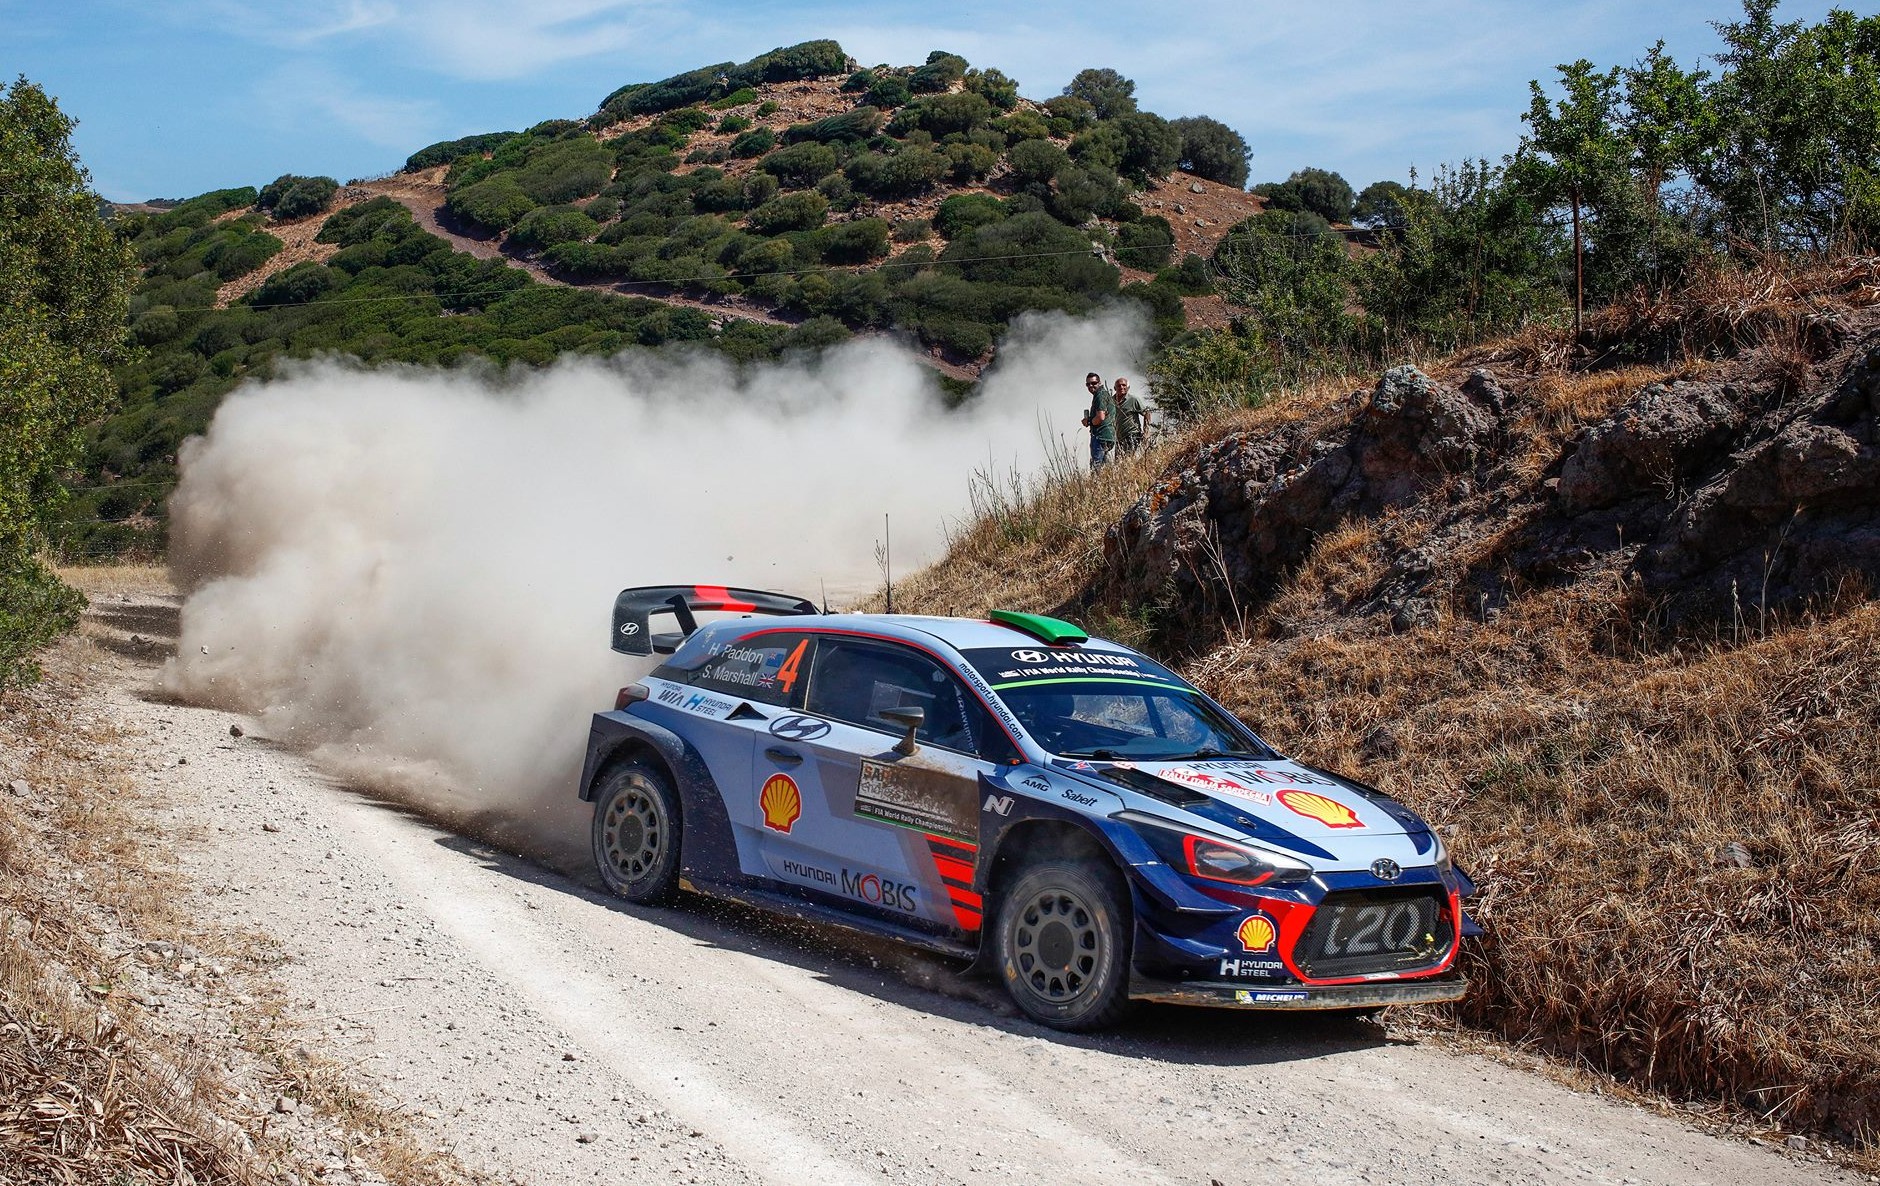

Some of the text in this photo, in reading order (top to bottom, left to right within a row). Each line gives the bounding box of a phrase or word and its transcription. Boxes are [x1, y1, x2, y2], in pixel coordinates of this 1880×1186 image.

[708, 643, 764, 664] H. Paddon
[1051, 651, 1139, 668] HYUNDAI
[776, 638, 809, 693] 4
[1025, 667, 1042, 676] FIA
[1043, 666, 1067, 675] World
[1067, 665, 1089, 675] Rally
[1087, 667, 1140, 678] Championship
[702, 664, 758, 686] S. Marshall
[695, 705, 717, 716] STEEL
[702, 696, 734, 712] HYUNDAI
[959, 662, 1024, 741] motorsport.hyundai.com
[1186, 761, 1268, 771] HYUNDAI
[1021, 779, 1050, 792] AMG
[1162, 770, 1270, 802] RALLY ITALIA SARDEGNA
[1225, 769, 1337, 787] MOBIS
[1061, 788, 1098, 807] Sabelt
[874, 806, 884, 817] FIA
[884, 810, 900, 820] World
[901, 814, 914, 825] Rally
[783, 859, 917, 912] HYUNDAI MOBIS
[1324, 902, 1420, 956] i20
[1240, 969, 1271, 977] STEEL
[1241, 960, 1283, 970] HYUNDAI
[1255, 993, 1305, 1002] MICHELIN
